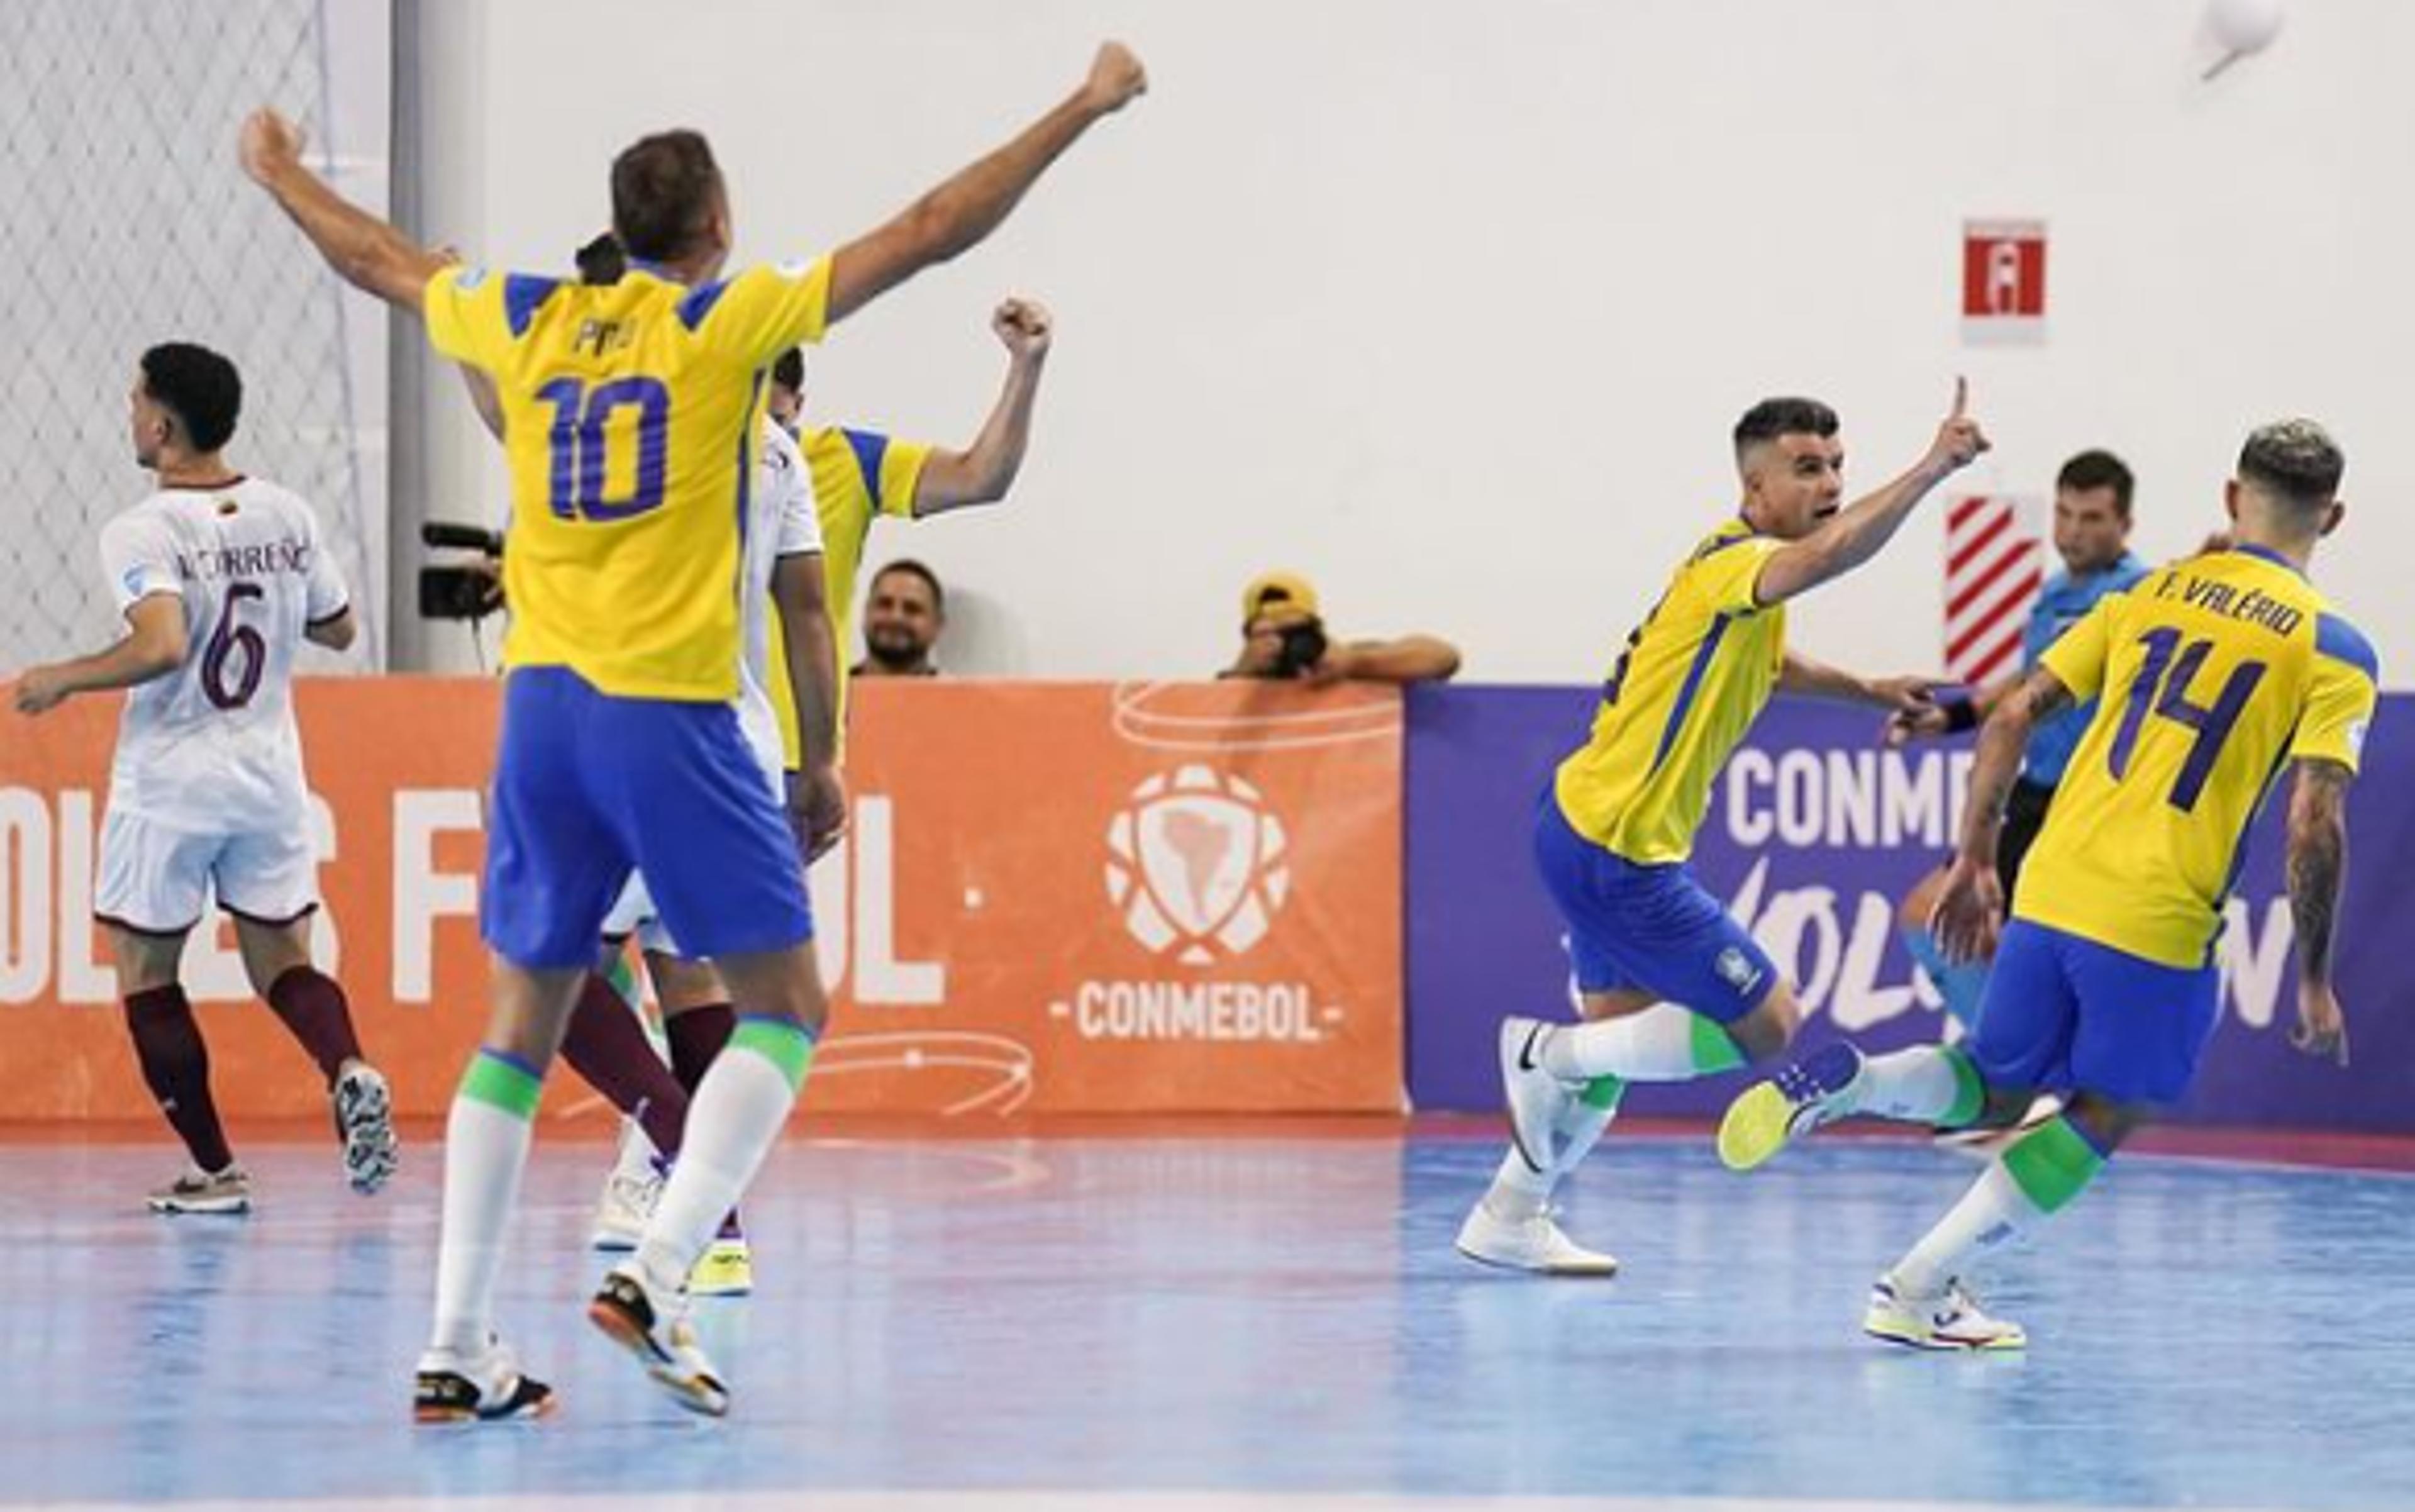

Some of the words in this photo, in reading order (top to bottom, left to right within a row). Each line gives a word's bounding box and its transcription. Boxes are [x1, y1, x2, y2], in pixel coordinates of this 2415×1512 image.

[533, 377, 669, 521] 10
[201, 583, 265, 709] 6
[2184, 577, 2304, 638] VALÉRIO
[2109, 626, 2268, 813] 14
